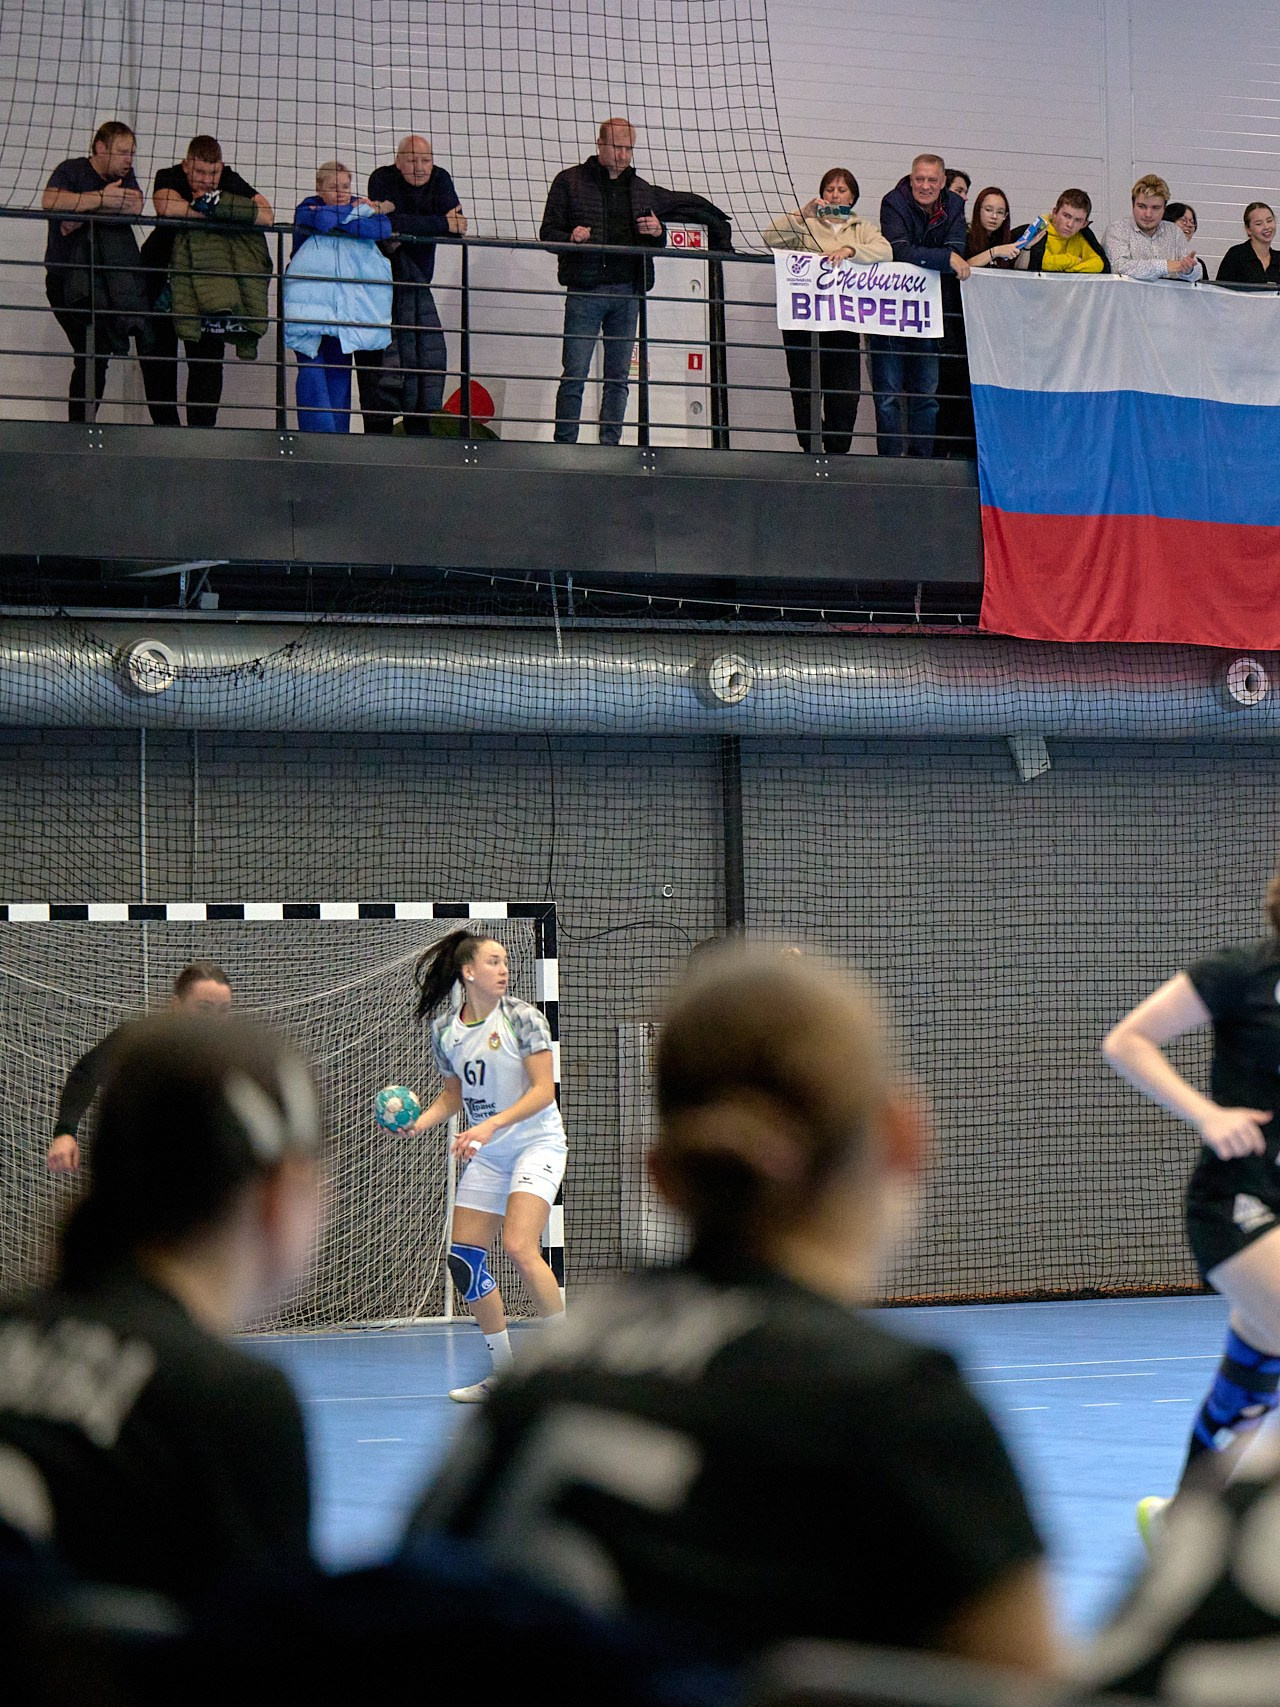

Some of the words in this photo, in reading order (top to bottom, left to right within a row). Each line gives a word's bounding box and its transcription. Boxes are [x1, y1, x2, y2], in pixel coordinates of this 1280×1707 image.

[816, 256, 927, 293] Ежевички
[791, 292, 931, 333] ВПЕРЕД!
[464, 1059, 486, 1086] 67
